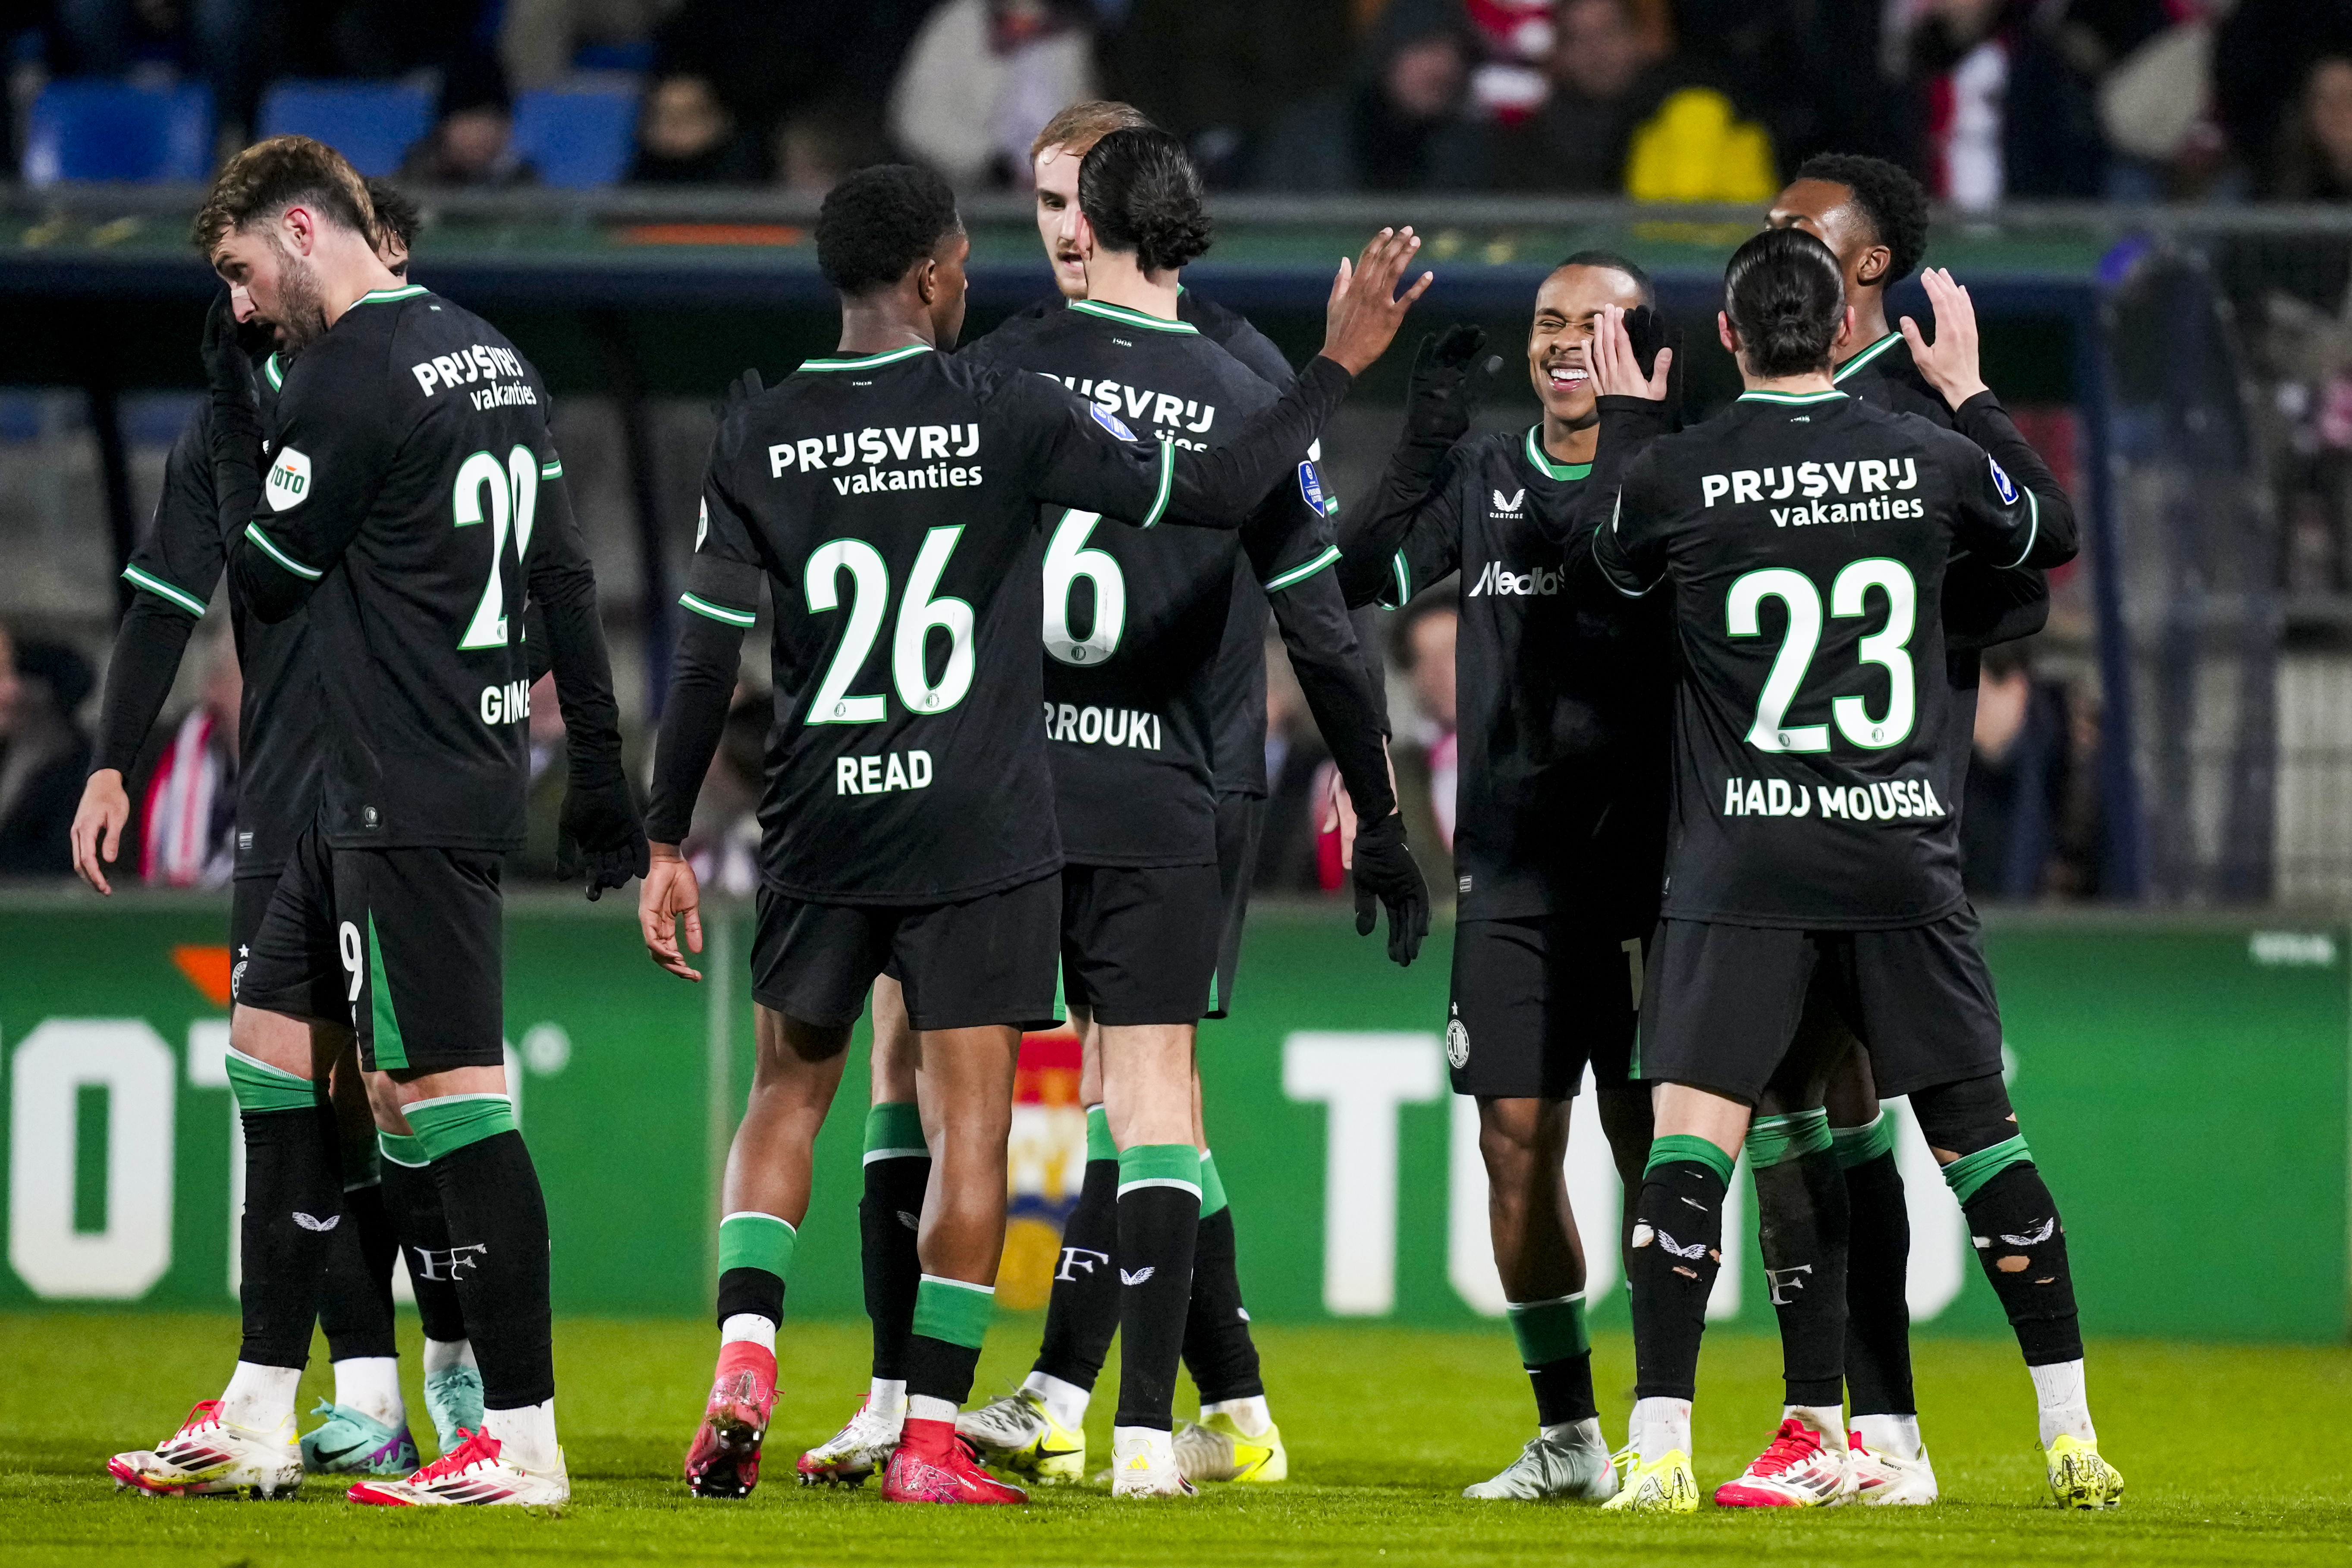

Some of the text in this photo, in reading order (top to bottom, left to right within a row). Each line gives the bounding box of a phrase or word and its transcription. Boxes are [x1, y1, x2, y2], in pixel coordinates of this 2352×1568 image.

[1112, 338, 1132, 347] 1908
[470, 380, 537, 411] vakanties
[271, 464, 305, 494] TOTO
[832, 463, 983, 496] vakanties
[1770, 496, 1924, 528] vakanties
[1042, 508, 1127, 668] 6
[803, 524, 976, 726] 26
[1725, 556, 1918, 754] 23
[837, 749, 933, 795] READ
[1724, 777, 1947, 821] HADJ MOUSSA
[339, 921, 363, 1002] 9
[1055, 1247, 1109, 1282] F
